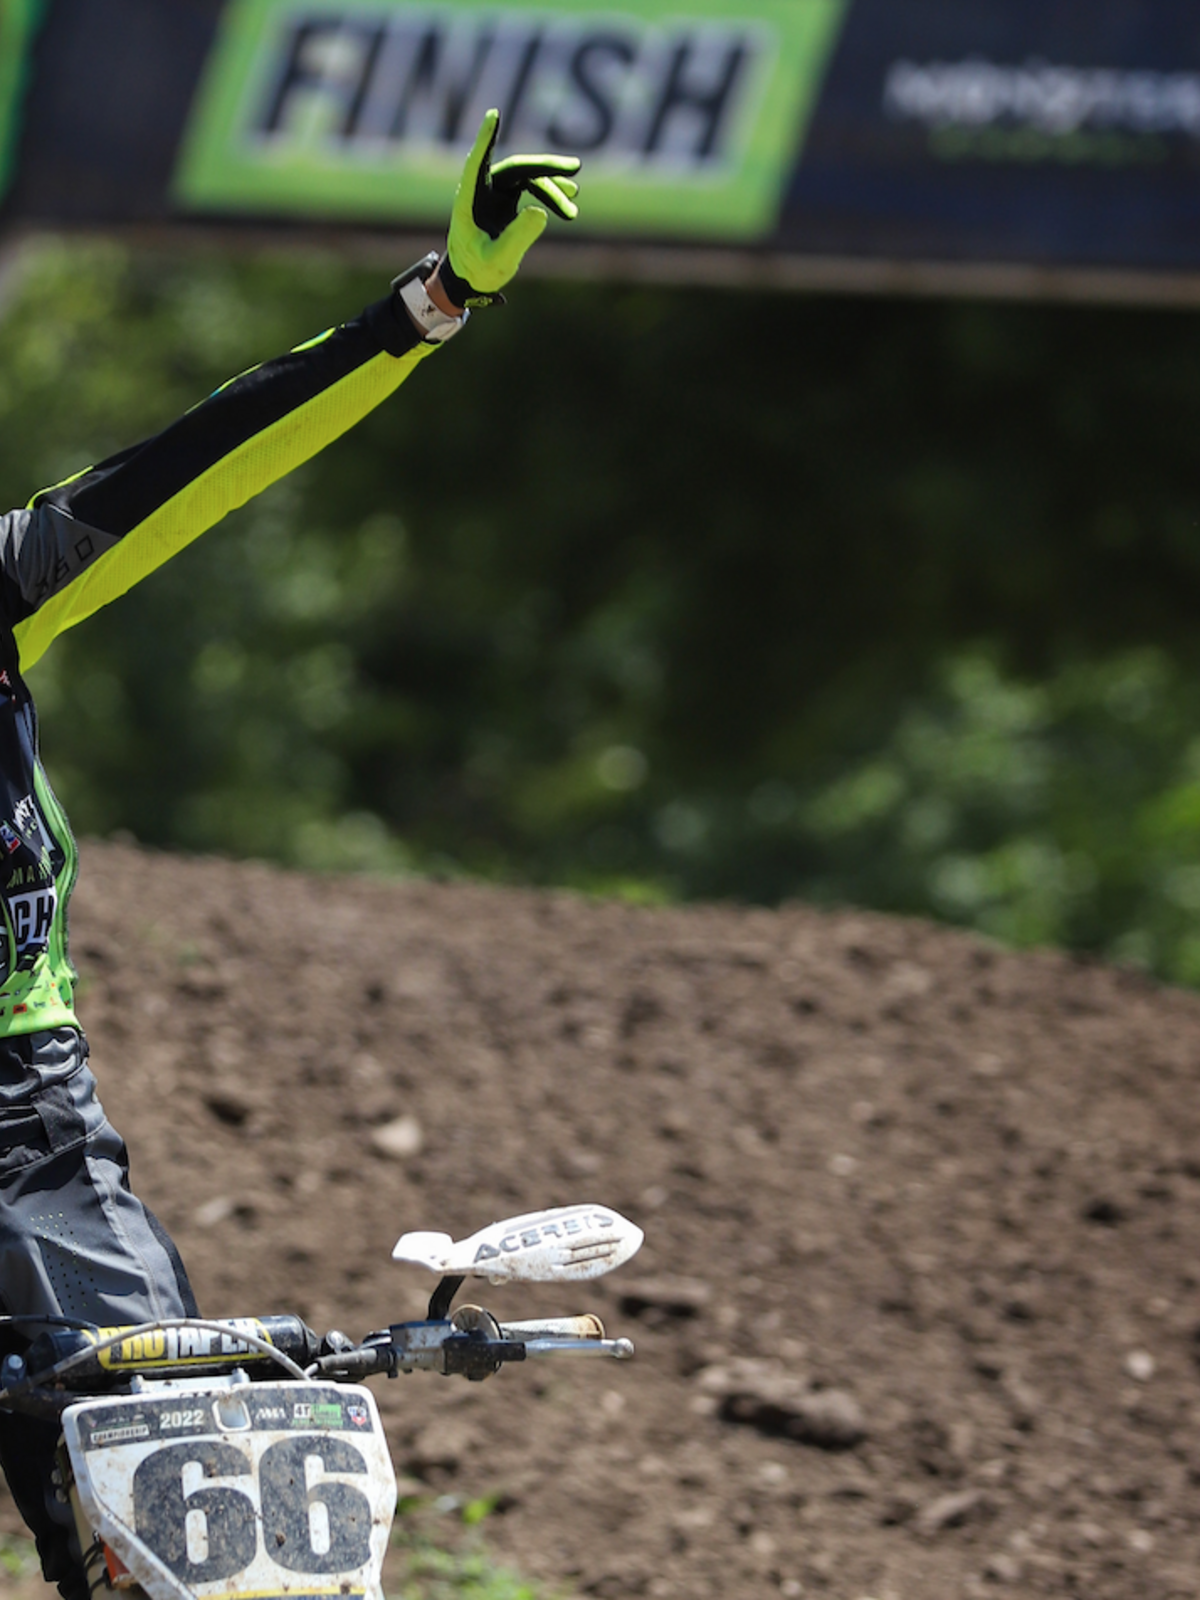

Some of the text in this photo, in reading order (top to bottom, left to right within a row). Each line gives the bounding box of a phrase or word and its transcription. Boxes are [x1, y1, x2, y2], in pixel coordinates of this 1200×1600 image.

[257, 20, 751, 158] FINISH
[160, 1409, 205, 1429] 2022
[133, 1435, 373, 1584] 66
